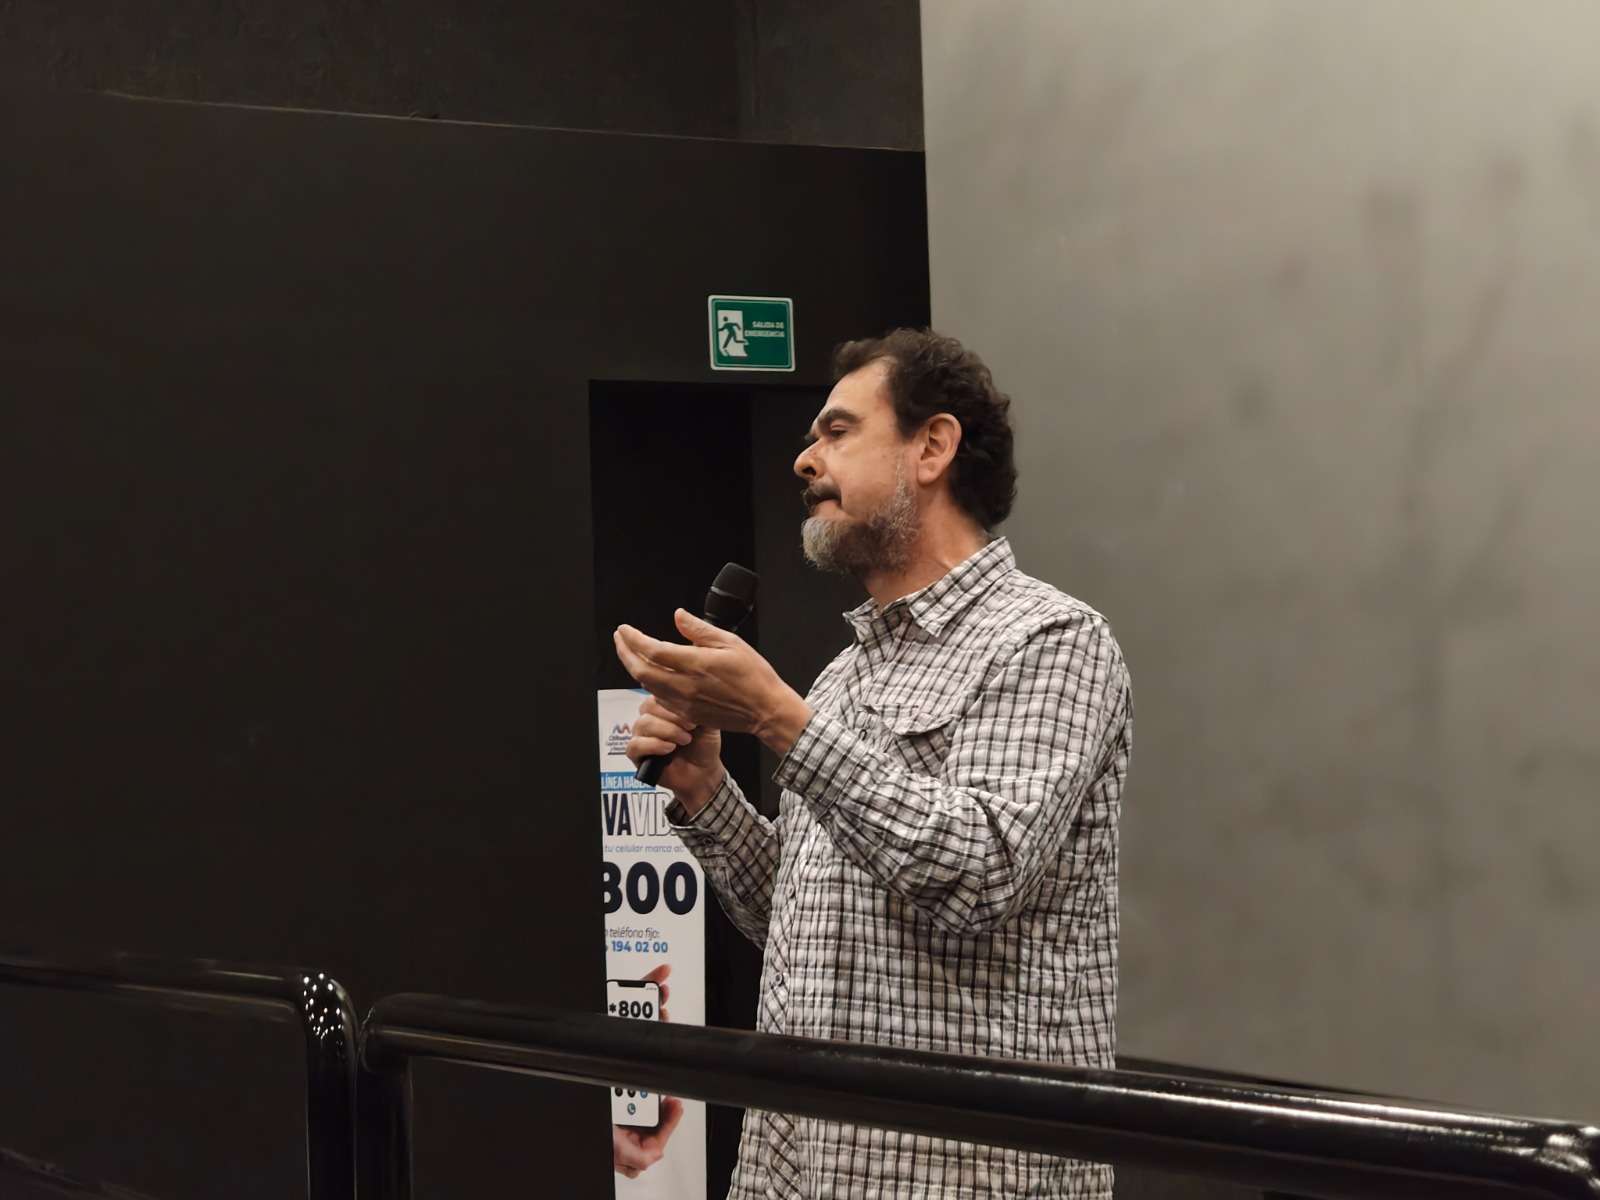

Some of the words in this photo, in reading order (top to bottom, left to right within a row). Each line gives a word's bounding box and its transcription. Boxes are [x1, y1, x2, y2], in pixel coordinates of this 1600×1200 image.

[615, 845, 643, 853] celular
[645, 845, 672, 853] marca
[603, 861, 697, 915] 800
[609, 926, 644, 938] teléfono
[611, 940, 631, 953] 194
[635, 941, 649, 953] 02
[652, 942, 668, 953] 00
